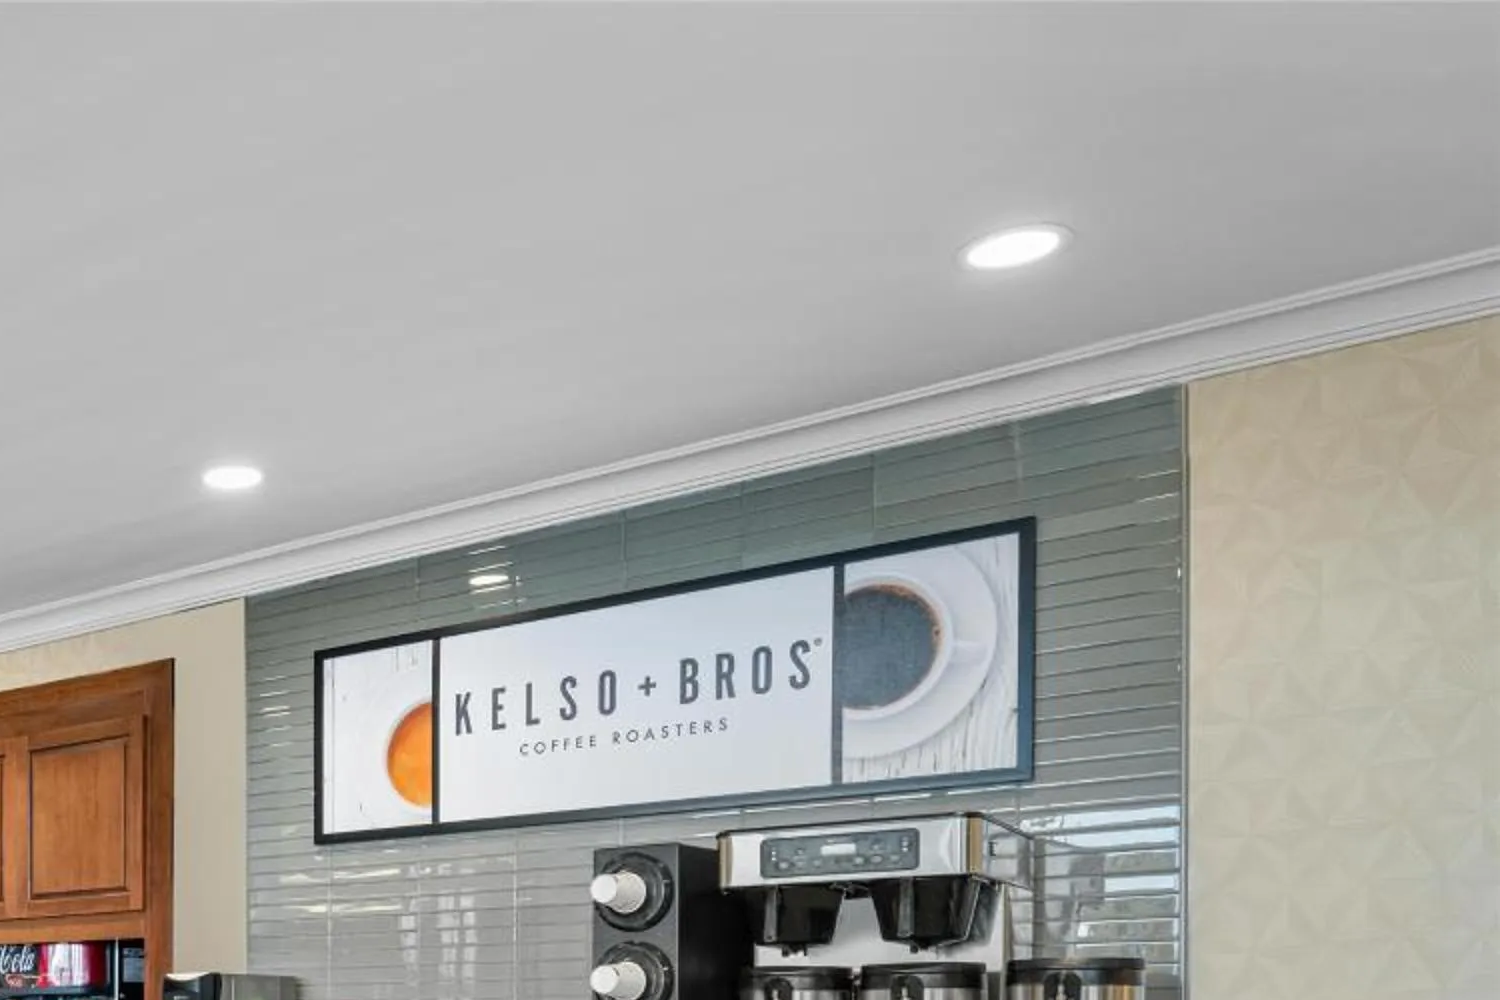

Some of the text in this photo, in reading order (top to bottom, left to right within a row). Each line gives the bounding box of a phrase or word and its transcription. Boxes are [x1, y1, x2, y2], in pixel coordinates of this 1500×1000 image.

[455, 669, 617, 736] KELSO
[519, 717, 729, 756] COFFEE ROASTERS
